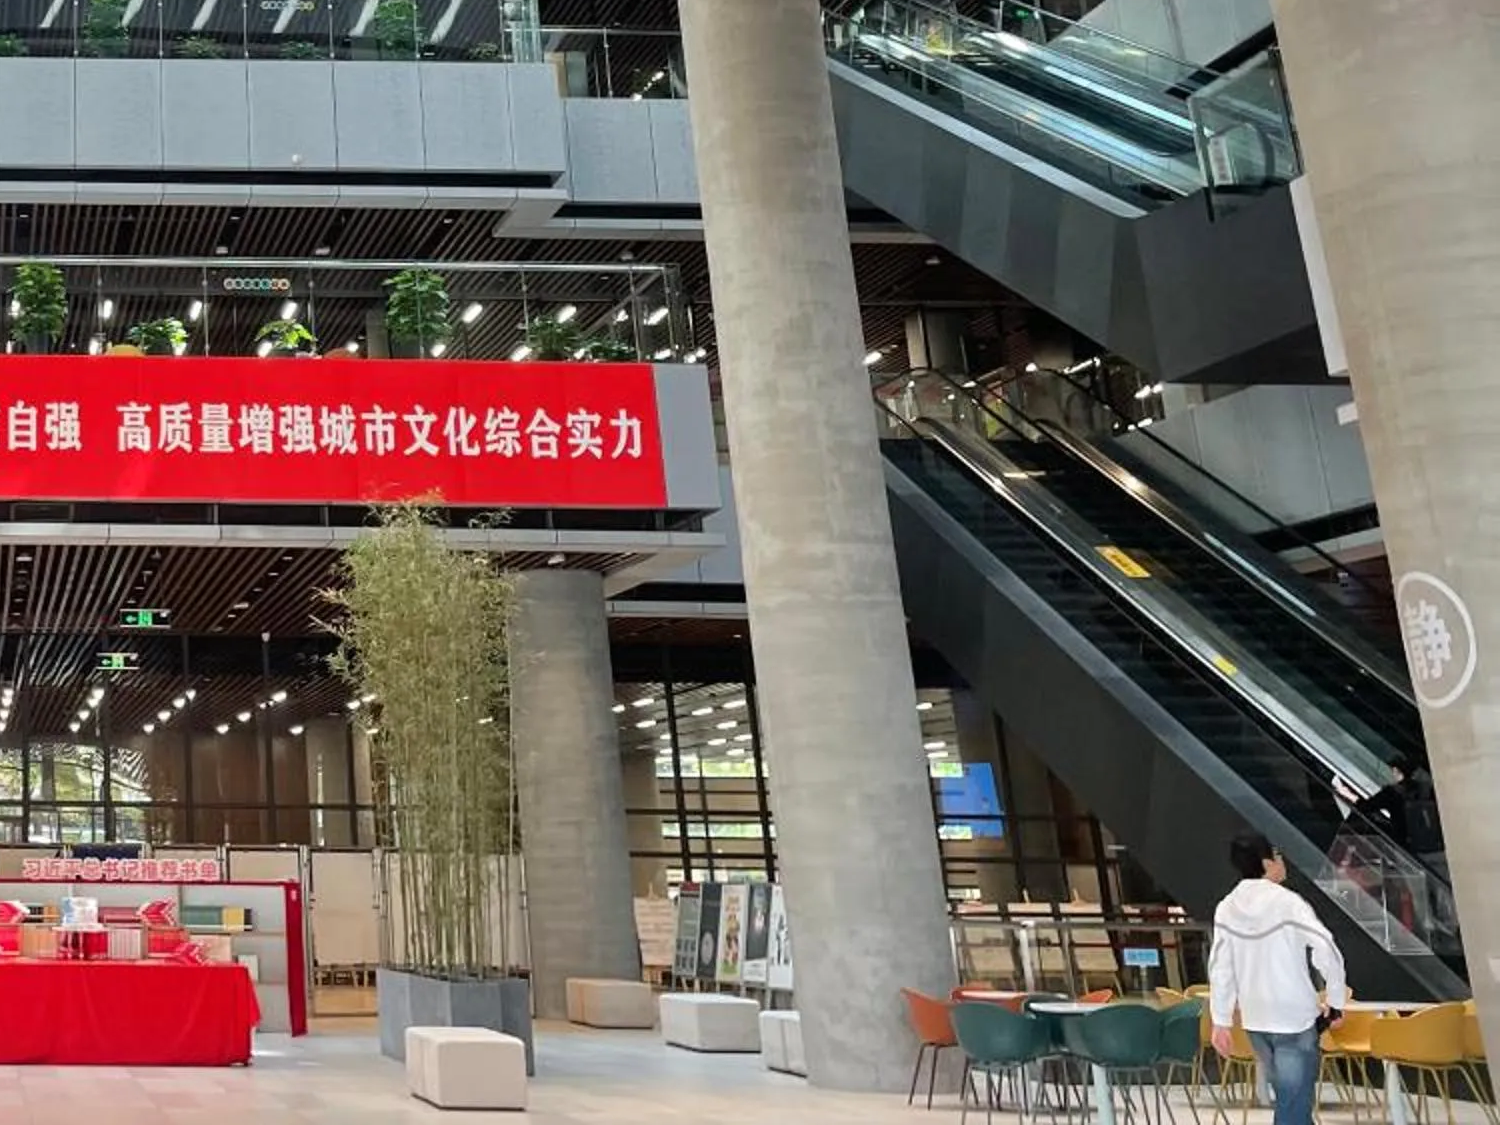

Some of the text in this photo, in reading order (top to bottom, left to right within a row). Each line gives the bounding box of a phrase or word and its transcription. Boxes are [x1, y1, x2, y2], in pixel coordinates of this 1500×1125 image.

[116, 401, 643, 459] 高质量增强城市文化综合实力
[1404, 599, 1452, 681] 静
[23, 858, 220, 881] 习近平总书记推荐书单
